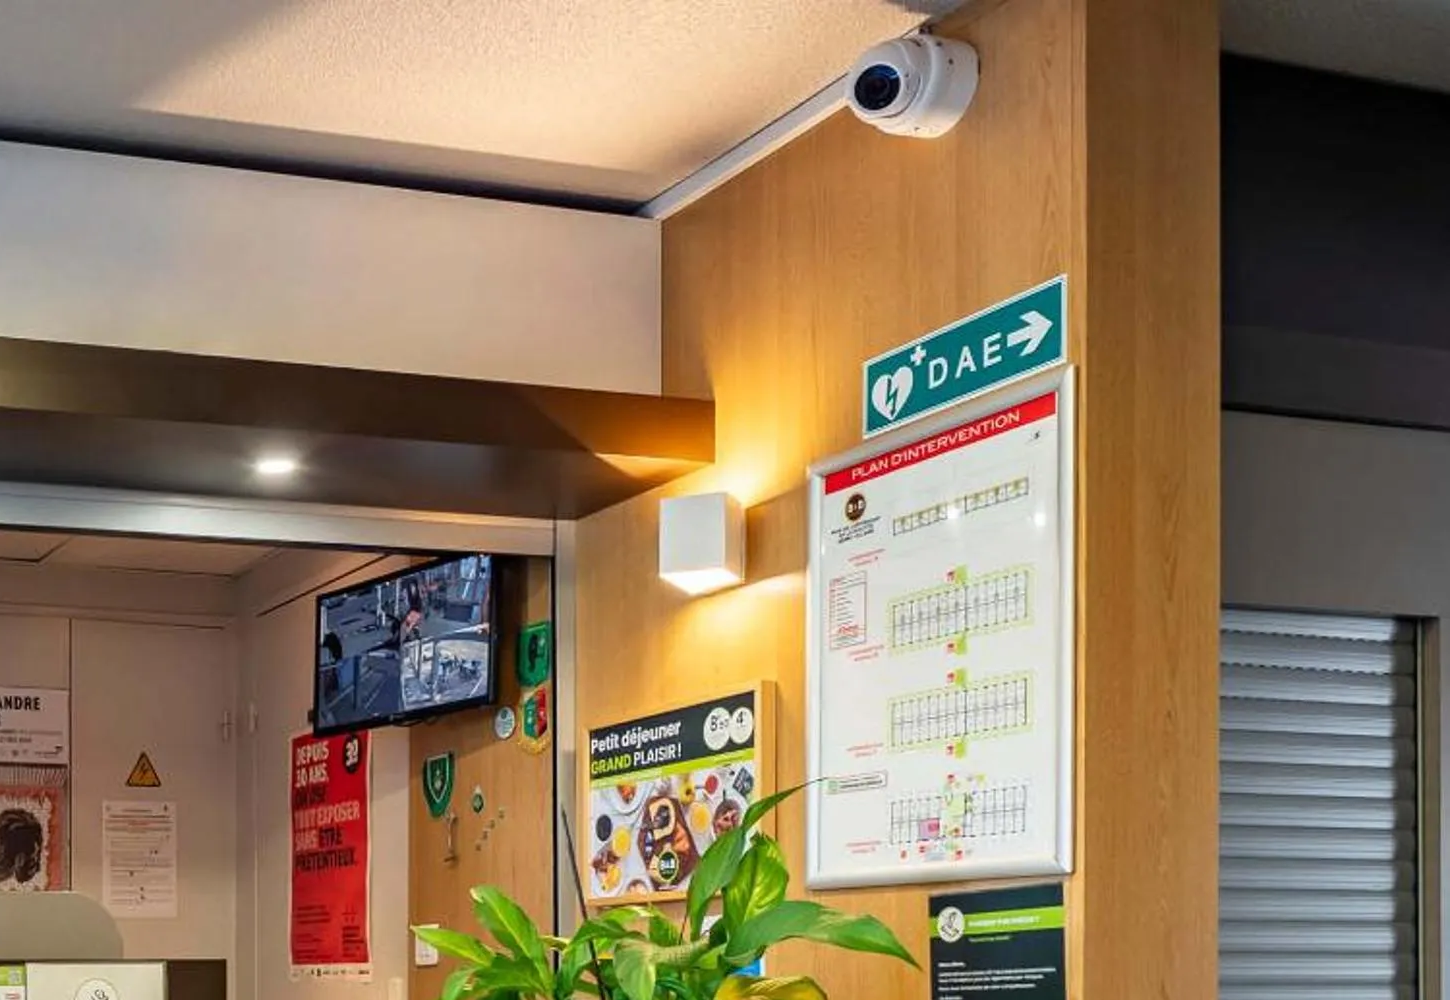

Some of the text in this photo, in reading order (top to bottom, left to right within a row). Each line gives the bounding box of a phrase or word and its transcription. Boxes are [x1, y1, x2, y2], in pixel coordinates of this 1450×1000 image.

[927, 332, 1002, 390] DAE
[851, 409, 1021, 480] PLAN D'INTERVENTION
[590, 720, 682, 755] Petit déjeuner
[591, 753, 632, 775] GRAND
[633, 743, 676, 767] PLAISIR
